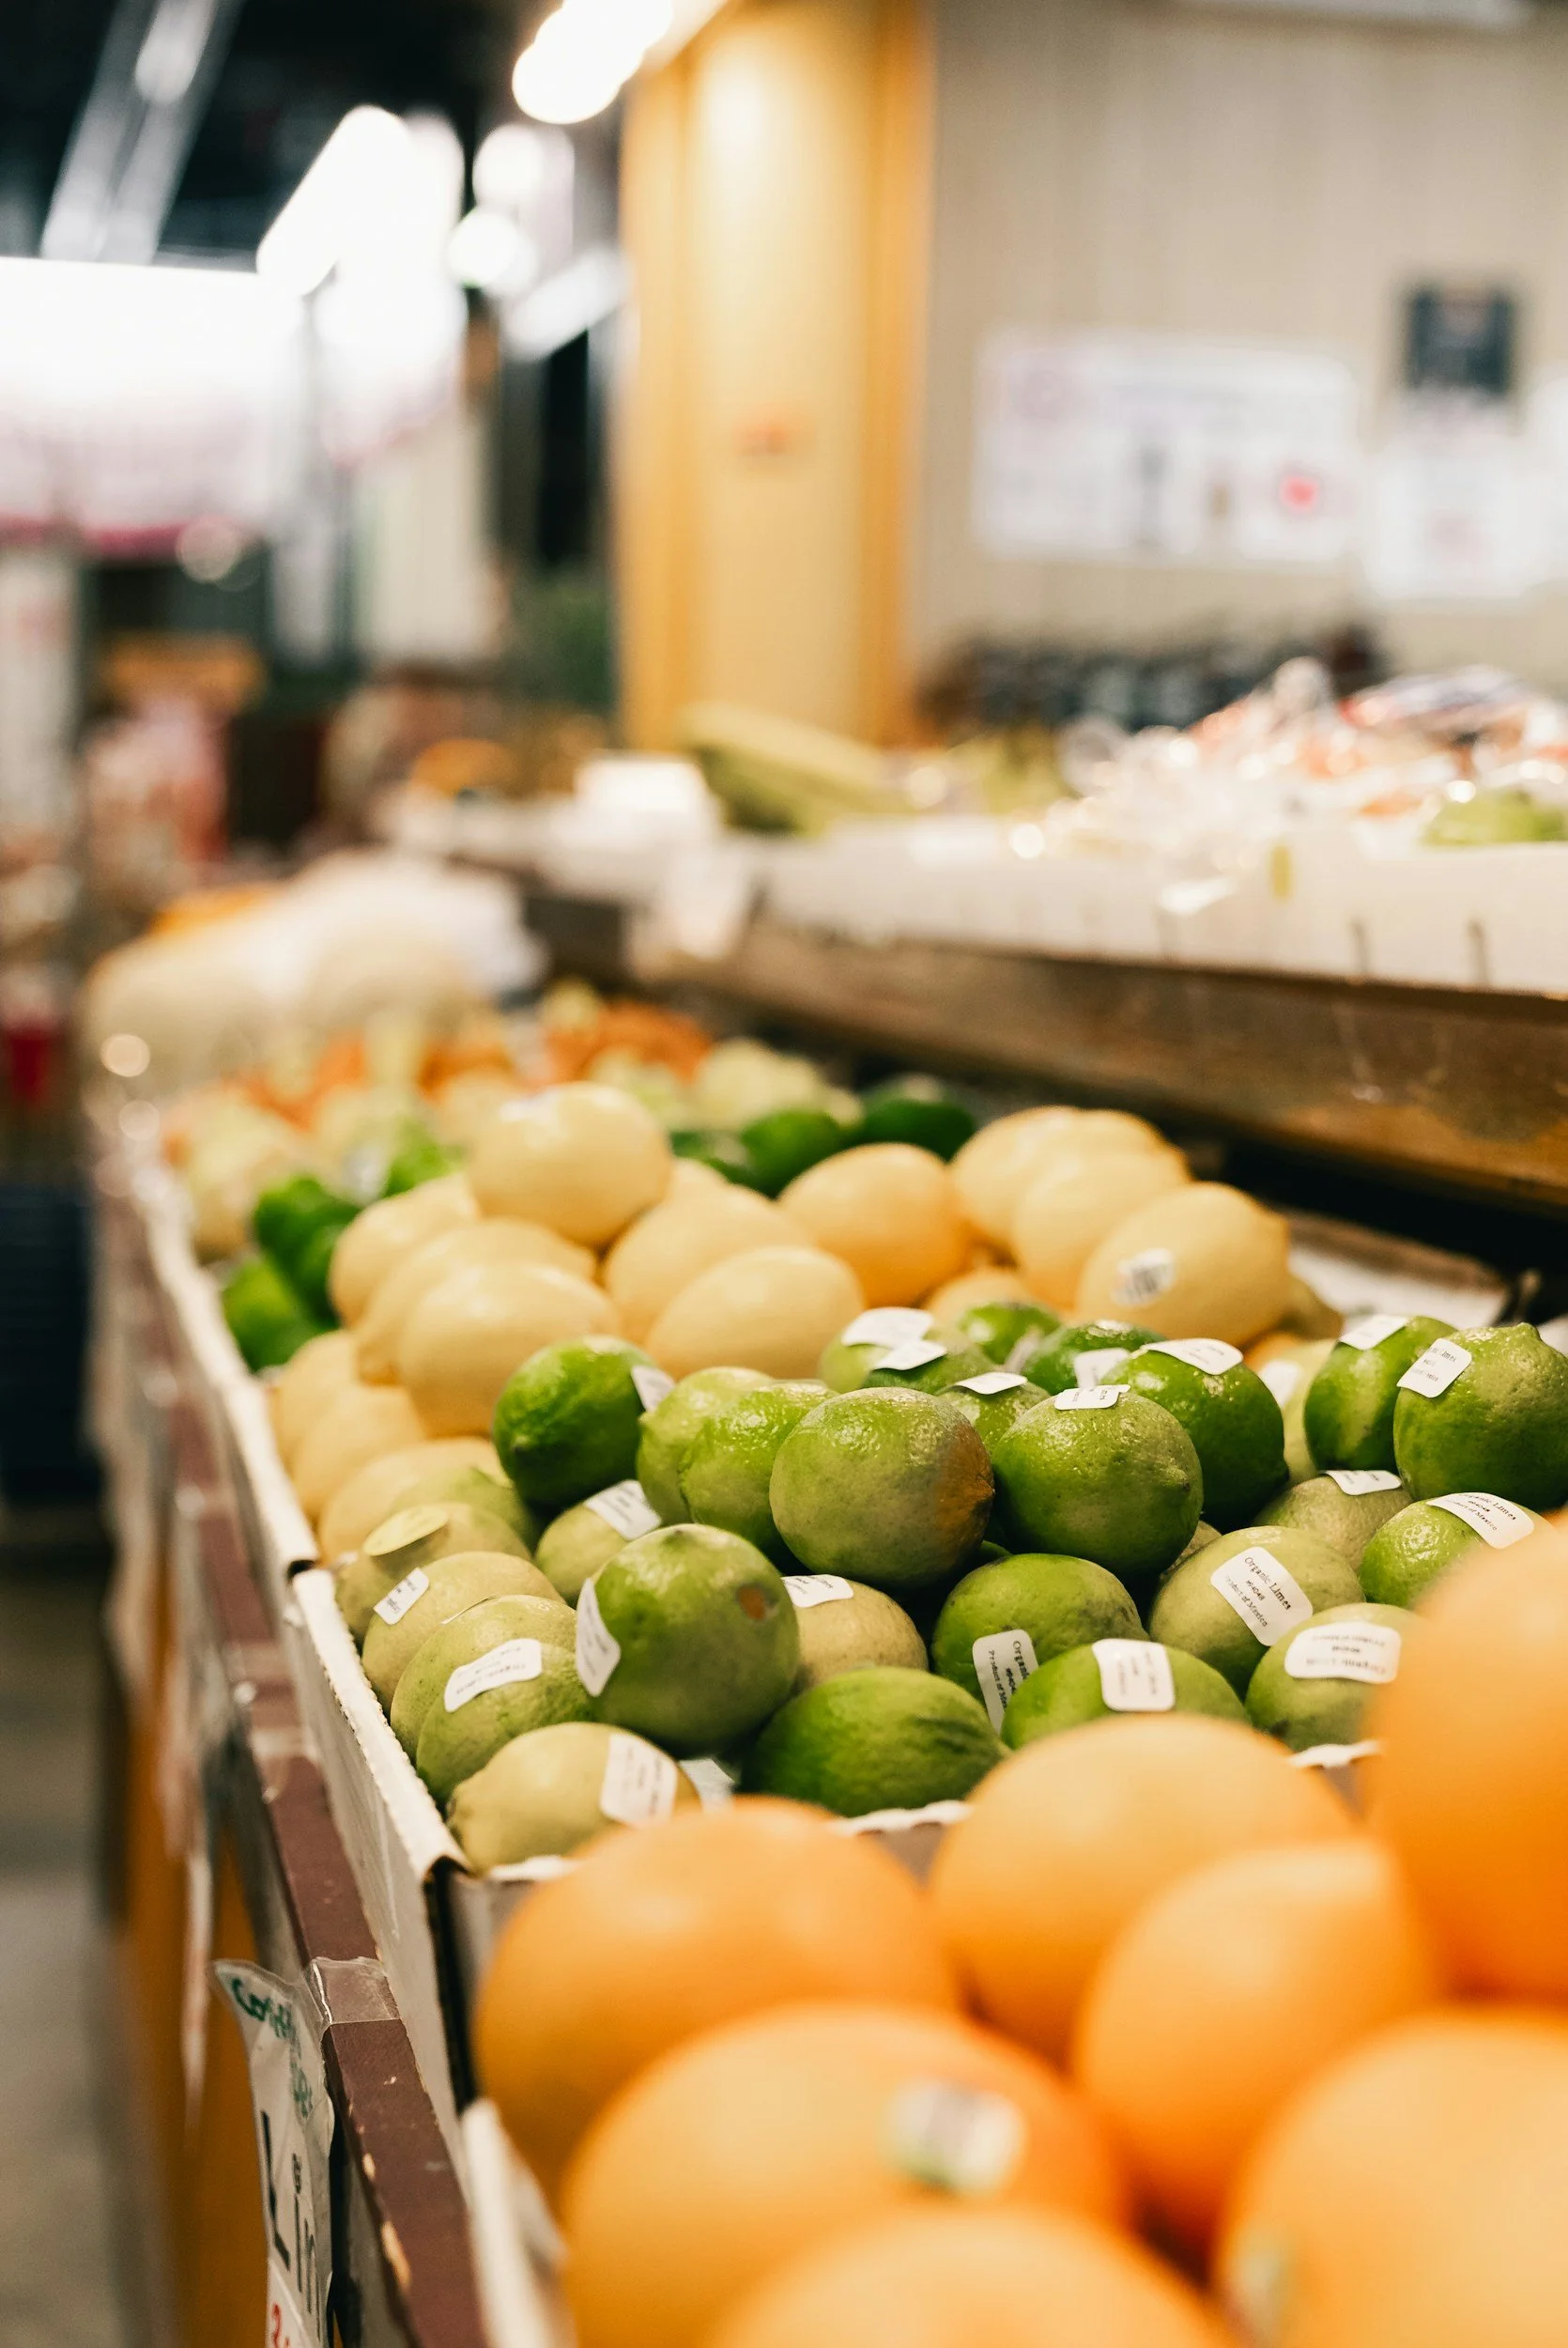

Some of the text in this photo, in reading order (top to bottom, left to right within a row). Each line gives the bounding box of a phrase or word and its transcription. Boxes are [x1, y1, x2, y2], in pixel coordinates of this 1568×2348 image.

[1475, 1511, 1498, 1531] Mexico
[1492, 1502, 1516, 1521] Limes
[1244, 1556, 1292, 1611] Organic Limes
[1247, 1601, 1268, 1628] Mexico
[988, 1649, 1000, 1682] Product
[996, 1683, 1004, 1691] of
